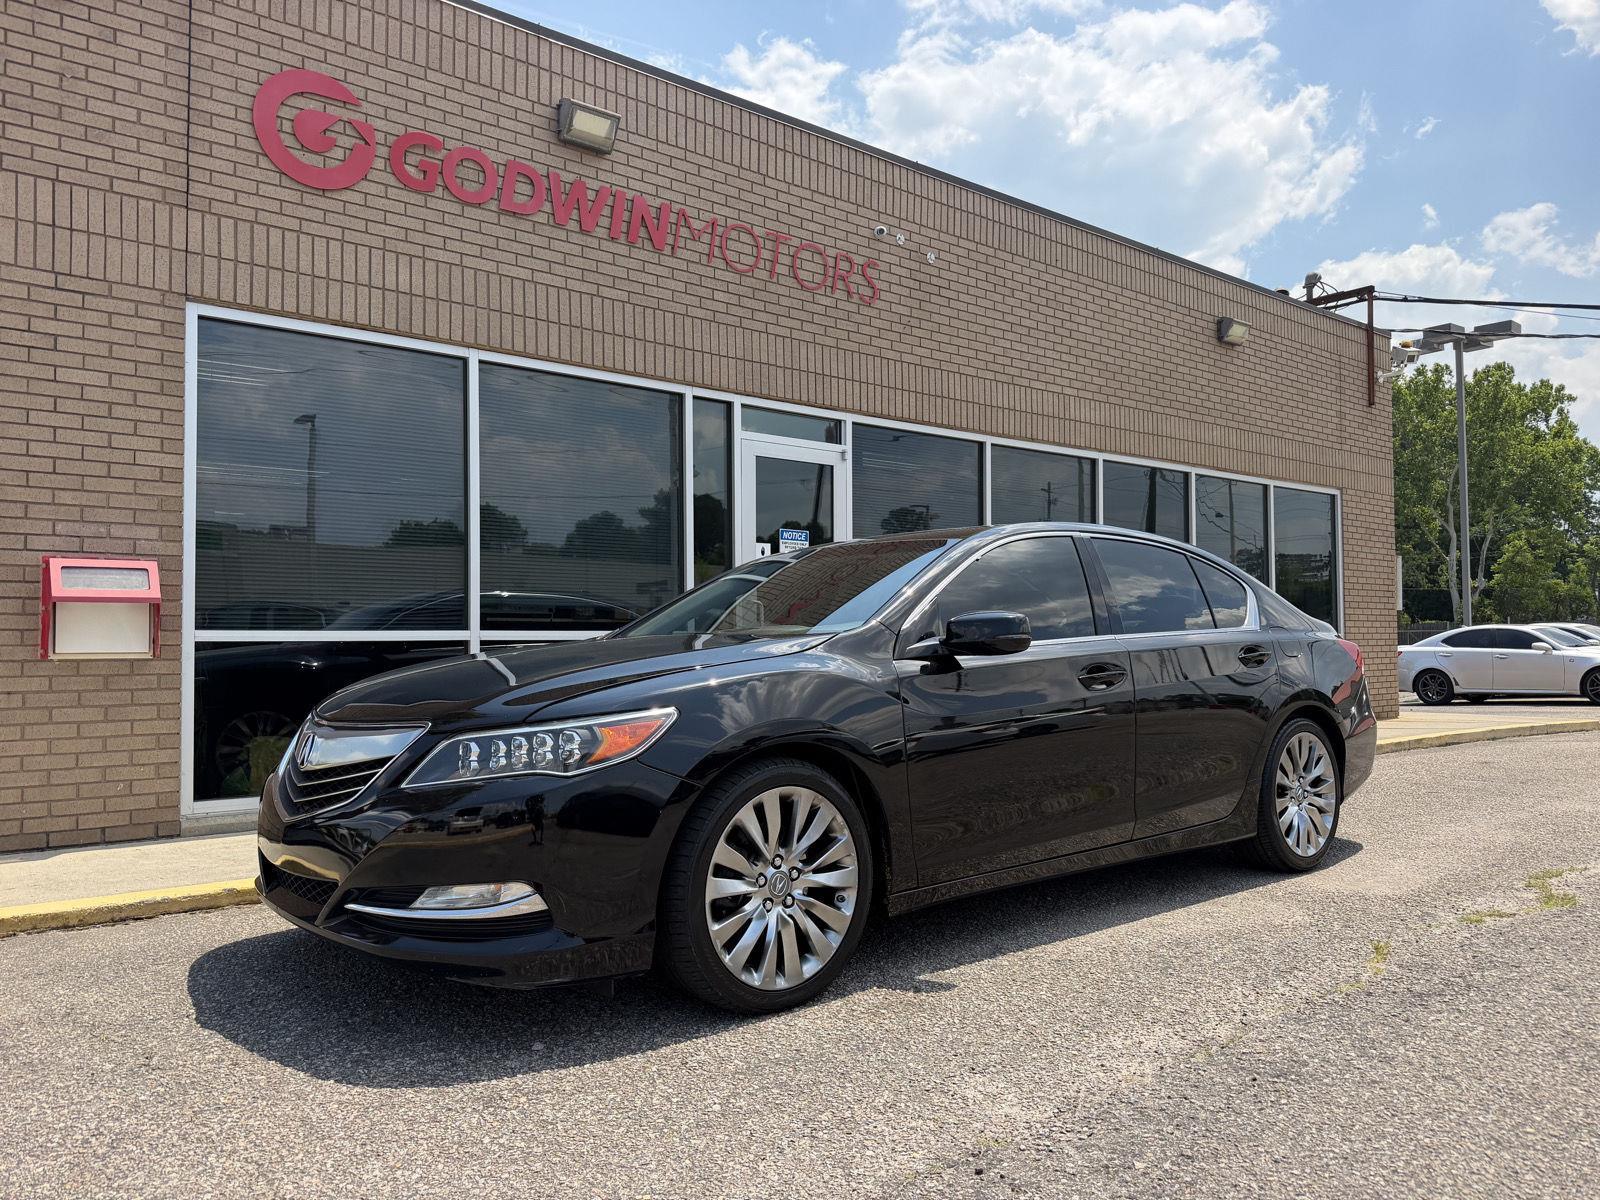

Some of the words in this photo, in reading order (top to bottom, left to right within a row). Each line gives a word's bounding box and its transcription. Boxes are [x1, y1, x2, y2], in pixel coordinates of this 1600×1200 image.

[389, 131, 672, 251] GODWIN
[672, 207, 881, 305] MOTORS
[782, 531, 806, 540] NOTICE
